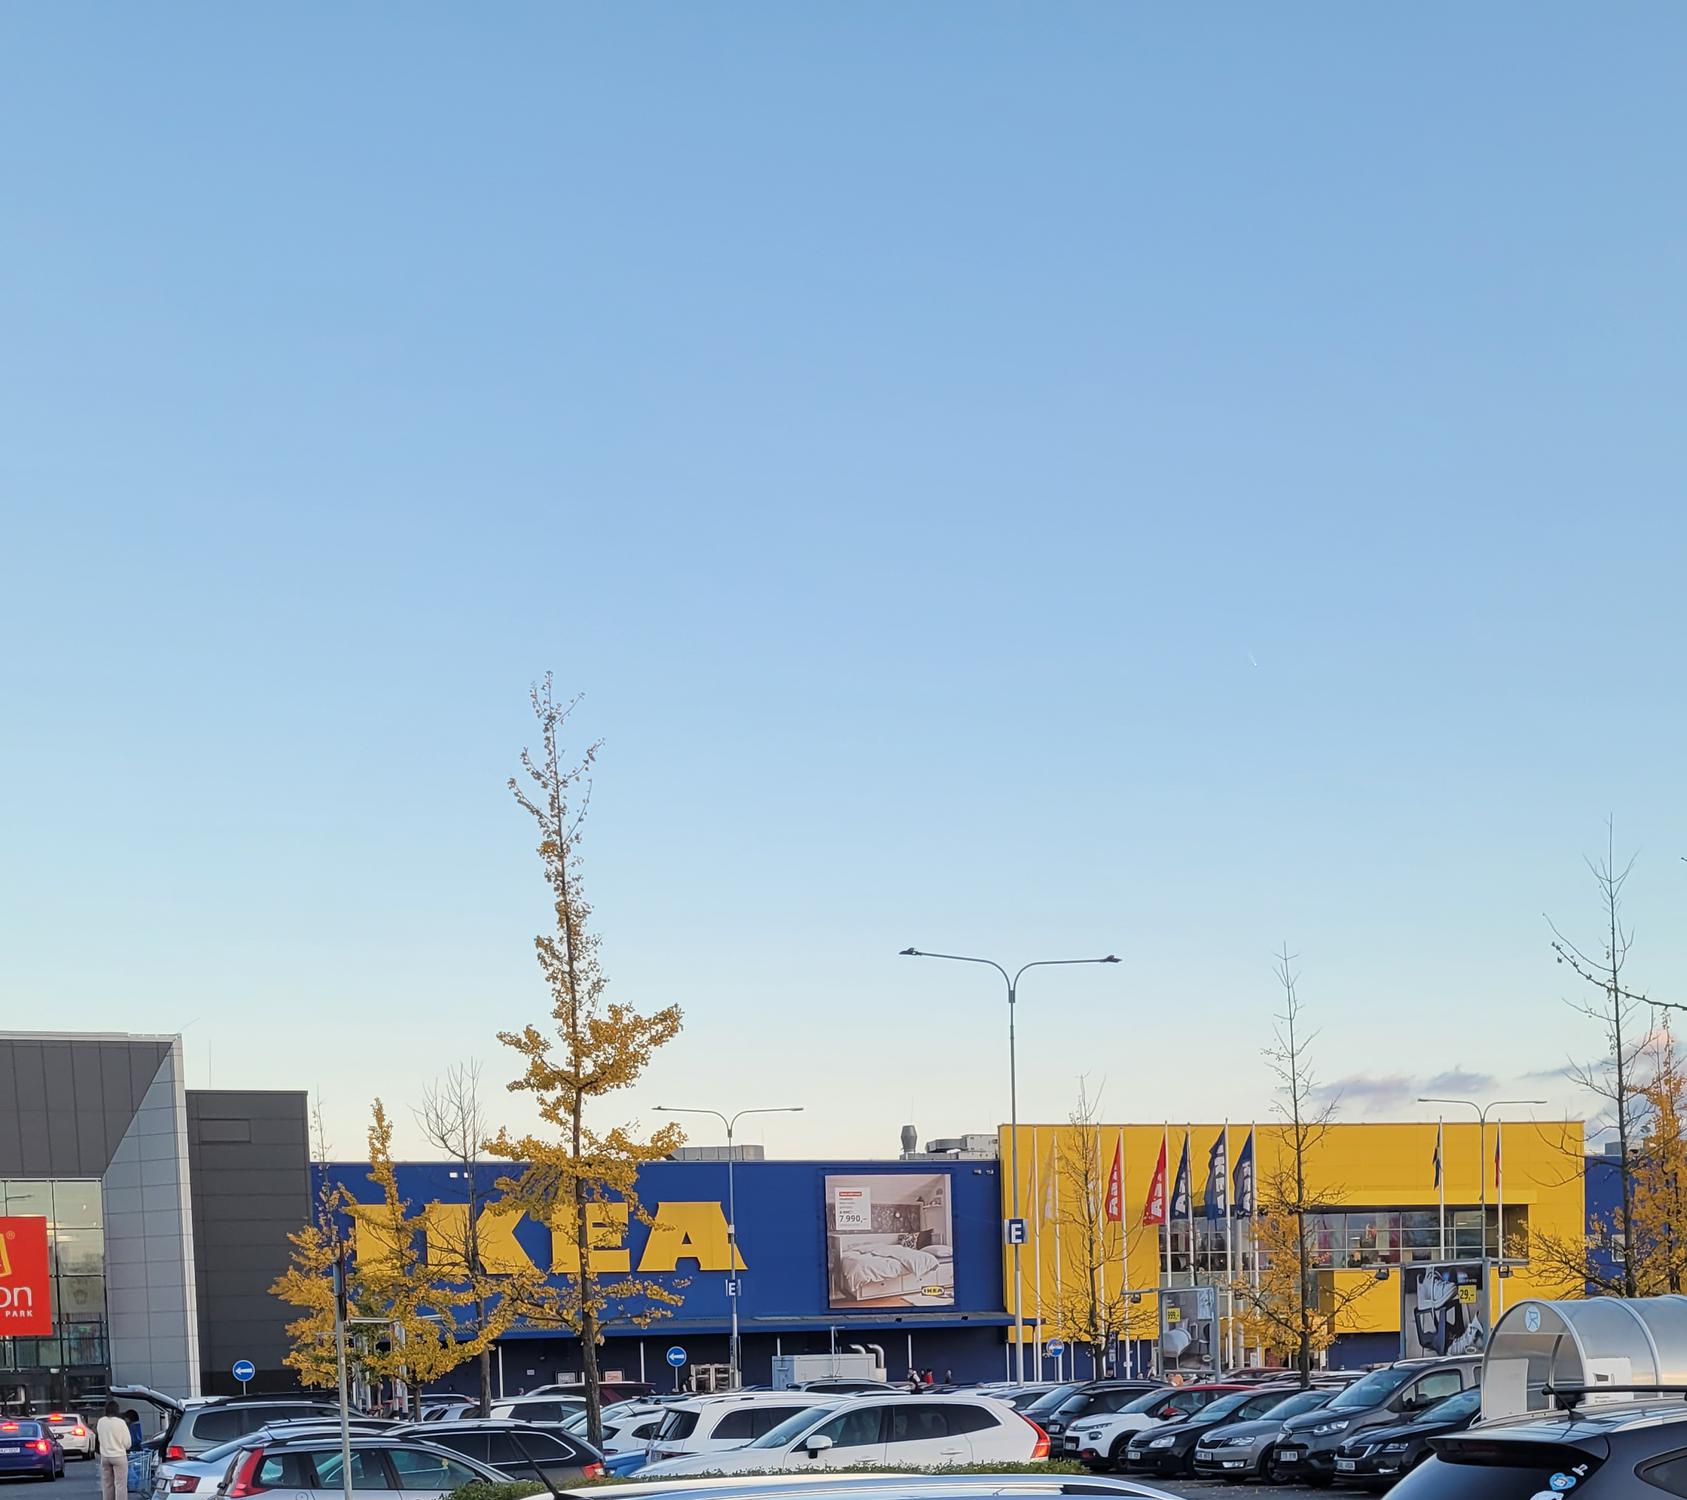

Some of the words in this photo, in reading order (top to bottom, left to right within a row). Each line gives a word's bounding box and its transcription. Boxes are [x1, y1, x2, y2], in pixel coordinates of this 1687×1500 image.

[355, 1201, 748, 1274] IKEA
[1011, 1223, 1022, 1243] E
[728, 1282, 736, 1296] E
[5, 1310, 33, 1318] PARK
